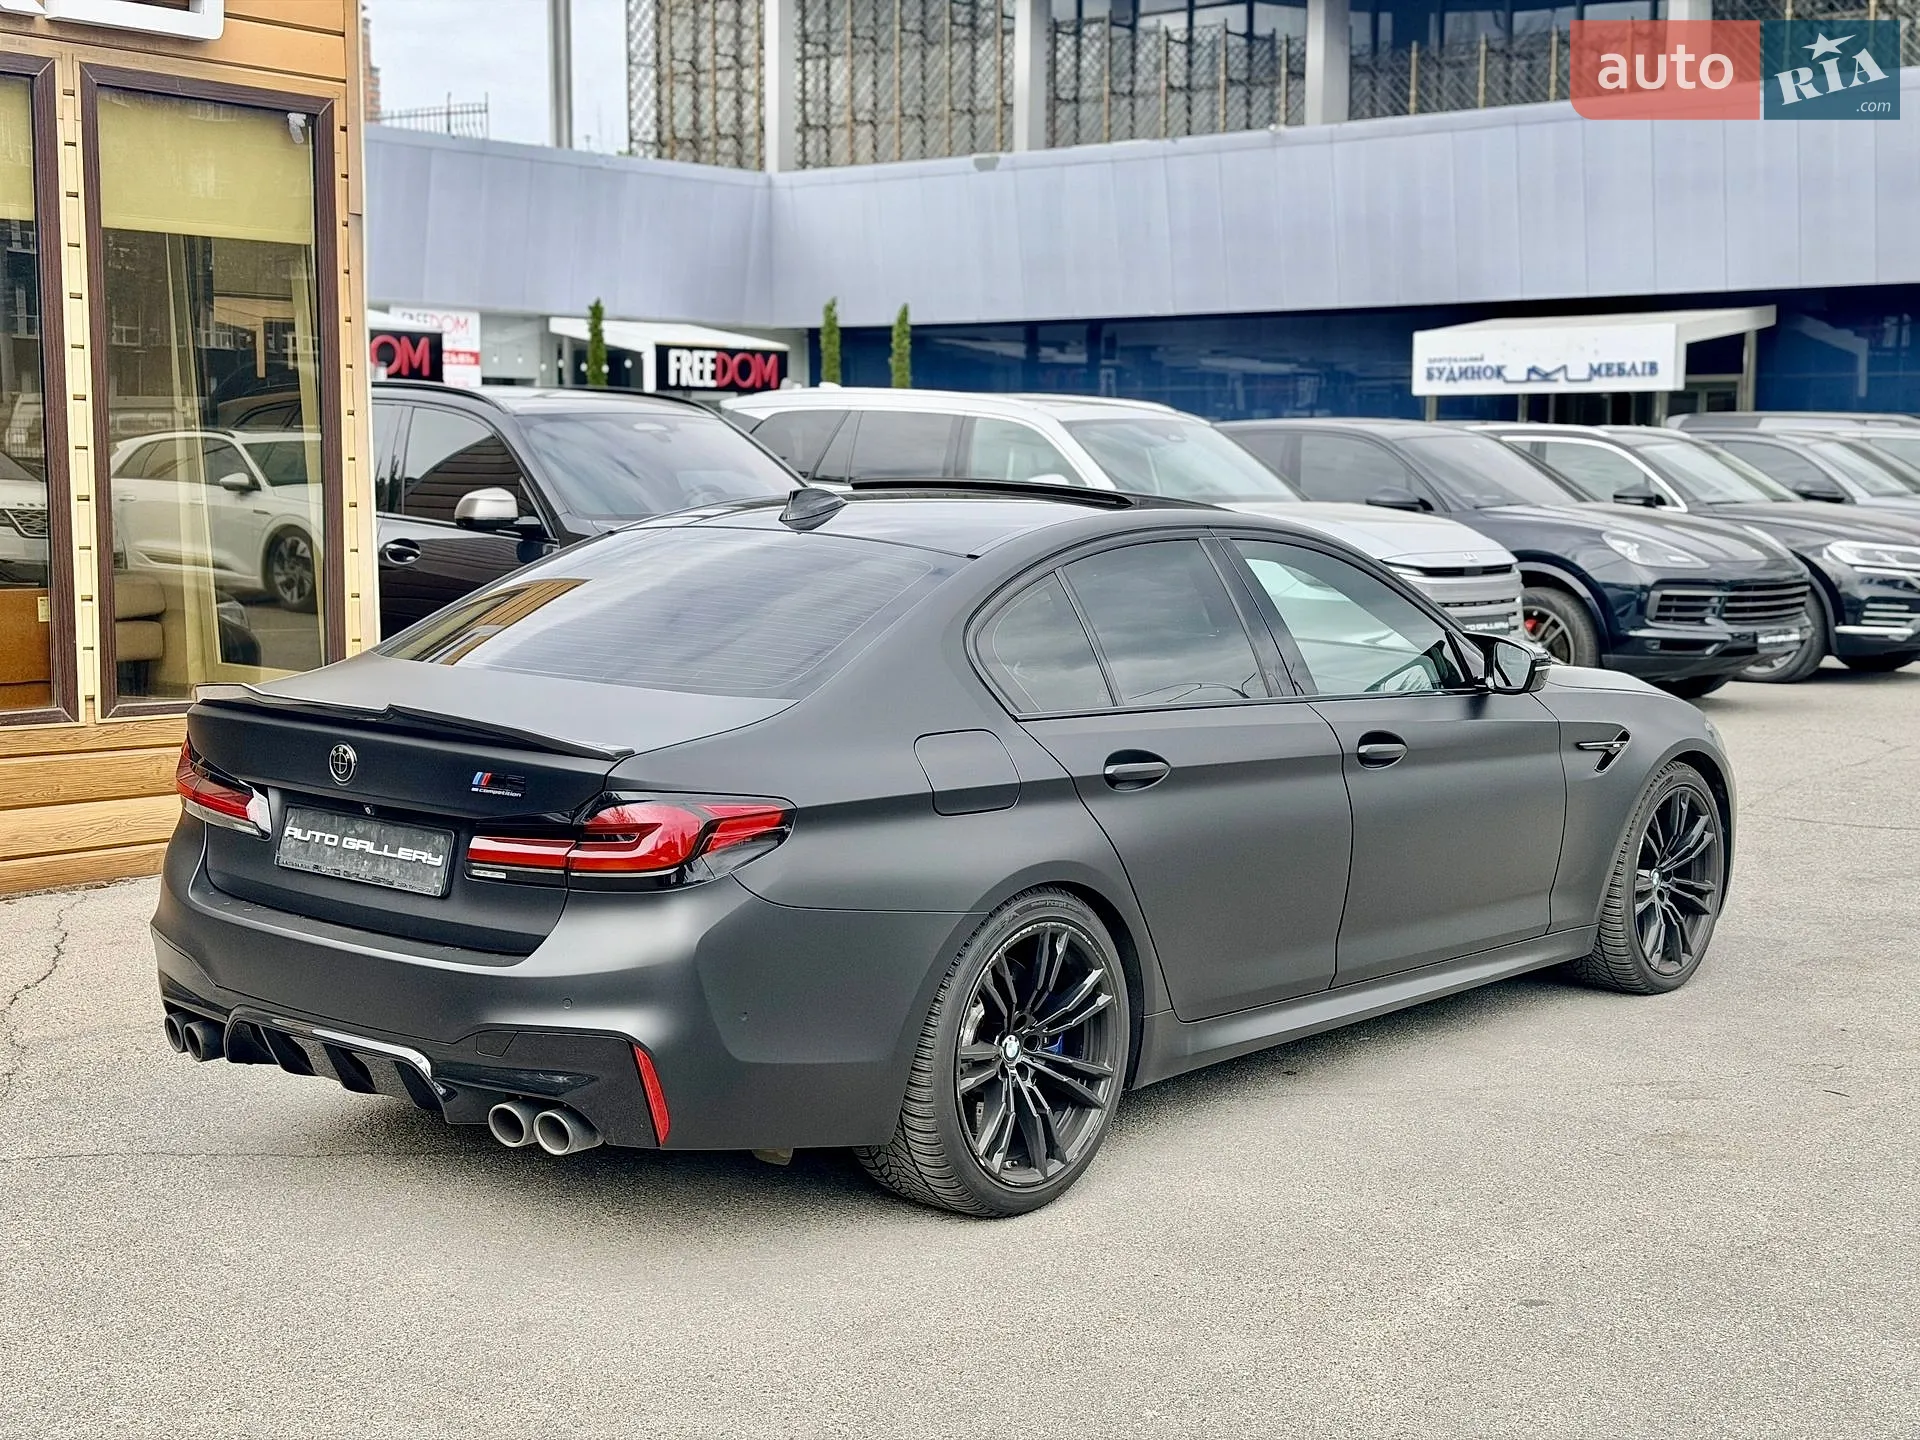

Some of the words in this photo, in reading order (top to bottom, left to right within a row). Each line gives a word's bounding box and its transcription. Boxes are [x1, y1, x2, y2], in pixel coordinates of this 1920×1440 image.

[668, 348, 778, 389] FREEDOM
[1426, 364, 1506, 383] БУДИНОК
[1588, 361, 1659, 378] МЕБЛІВ
[284, 826, 339, 847] AUTO
[342, 837, 443, 867] GALLERY
[312, 864, 341, 876] AUTO
